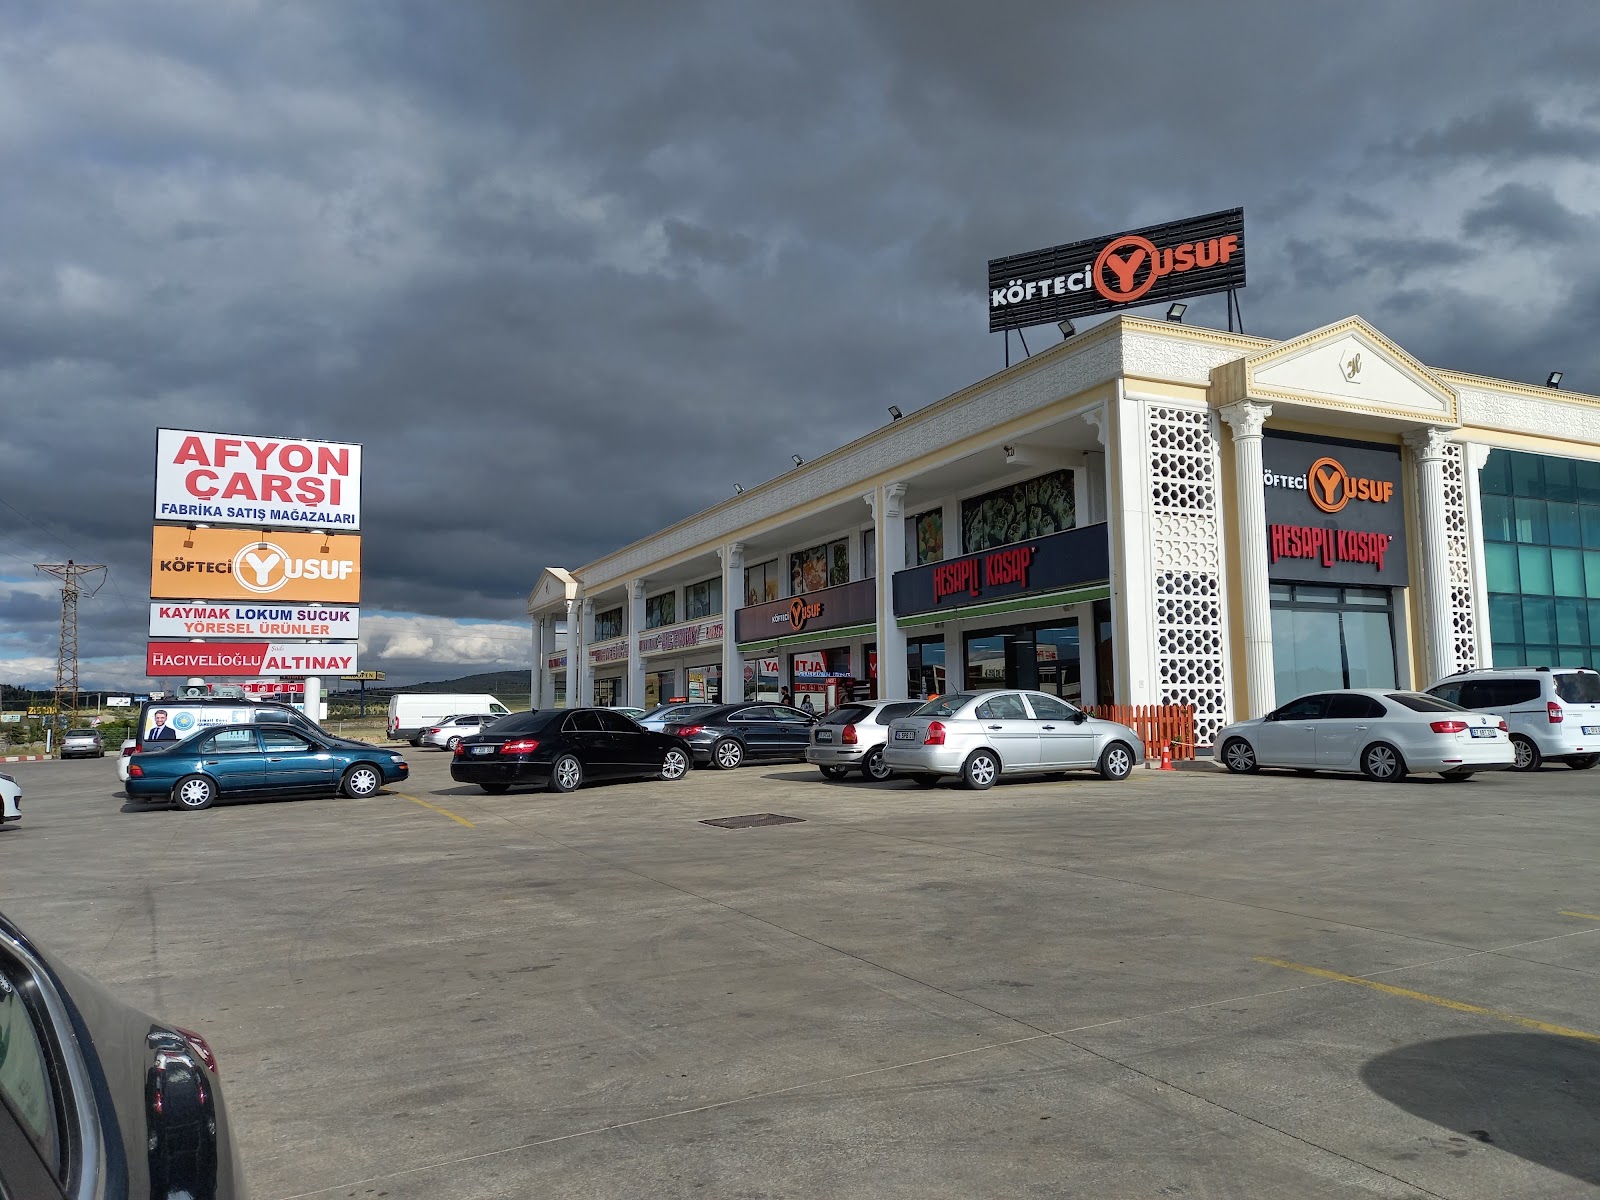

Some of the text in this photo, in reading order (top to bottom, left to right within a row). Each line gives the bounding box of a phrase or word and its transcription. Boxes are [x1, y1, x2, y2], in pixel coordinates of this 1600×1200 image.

[992, 234, 1238, 307] KÖFTECİ YUSUF
[172, 435, 349, 477] AFYON
[184, 469, 341, 508] ÇARŞI
[1263, 468, 1394, 504] ÖFTECİ YUSUF
[161, 503, 355, 524] FABRİKA SATIŞ MAĞAZALARI
[1271, 523, 1335, 568] HESAPLI
[1336, 529, 1388, 571] KASAP
[160, 553, 353, 586] KÖFTECİ YUSUF
[933, 559, 979, 604] HESAPLI
[985, 547, 1030, 588] KASAP
[159, 607, 350, 621] KAYMAK LOKUM SUCUK
[184, 621, 330, 635] YÖRESEL ÜRÜNLER
[792, 602, 821, 626] YUSUF
[152, 652, 262, 667] HACIVELİOĞLU
[265, 656, 353, 670] ALTINAY
